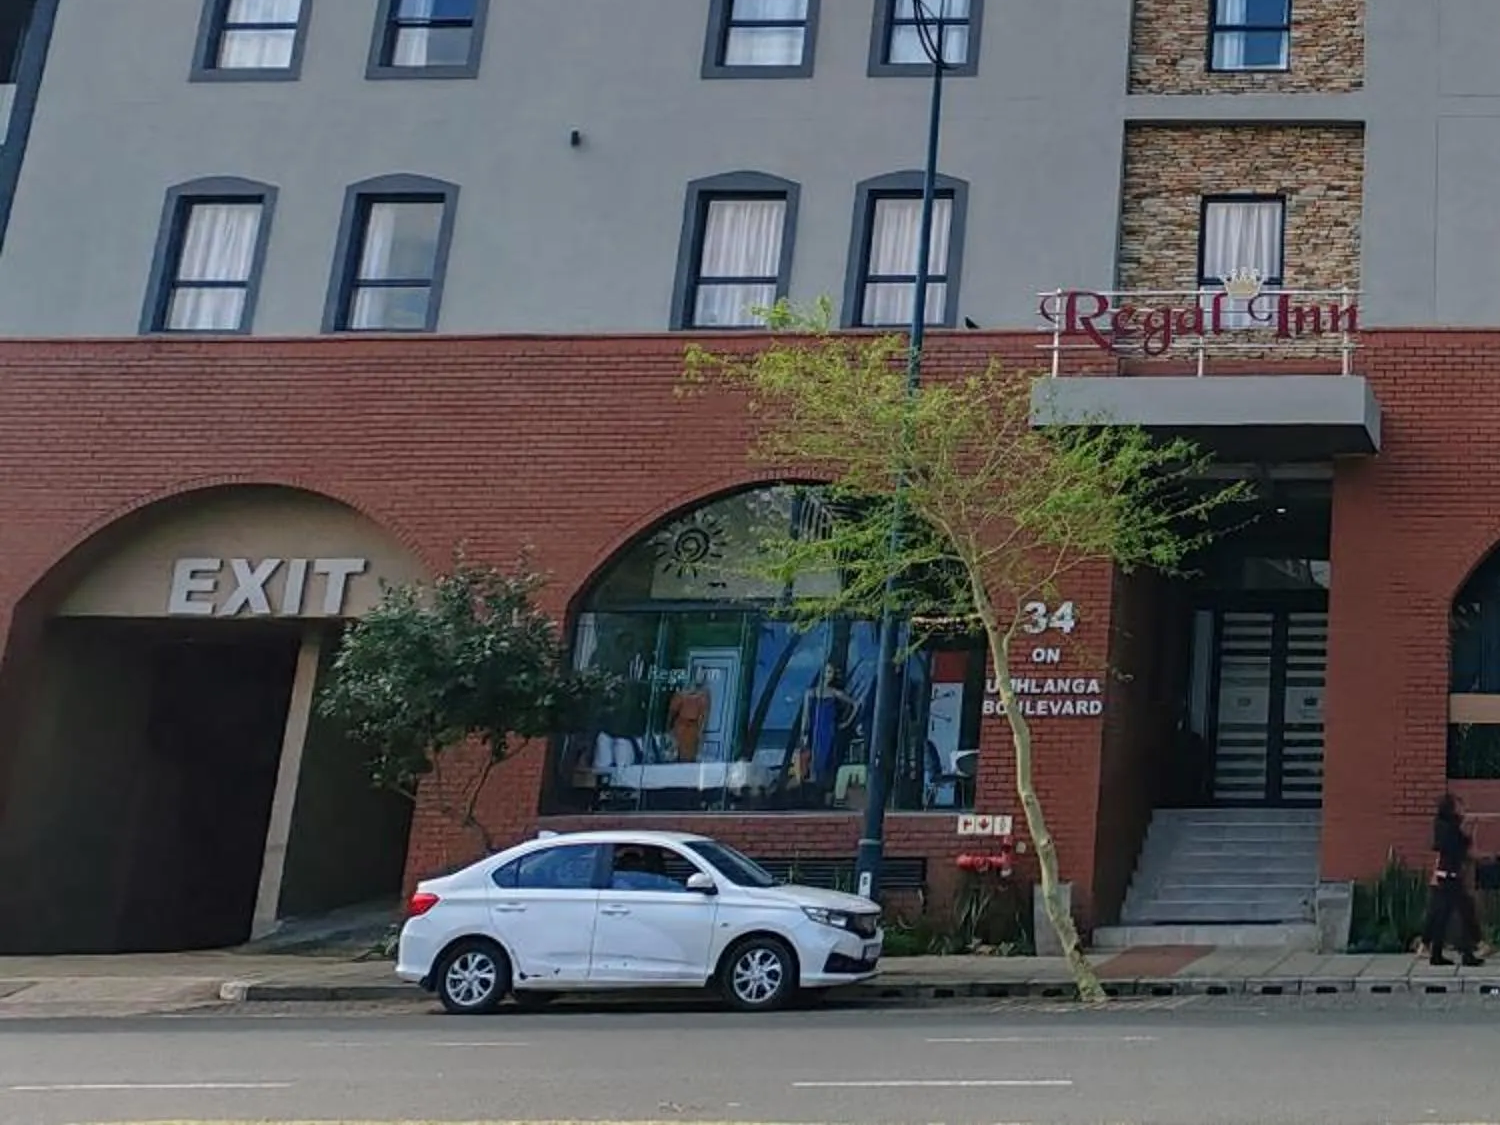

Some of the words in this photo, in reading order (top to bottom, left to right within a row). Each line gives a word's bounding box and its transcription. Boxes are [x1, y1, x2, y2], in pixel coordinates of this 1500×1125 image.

[1039, 290, 1228, 356] Regal
[1247, 292, 1361, 339] Inn
[168, 558, 367, 617] EXIT
[1023, 601, 1077, 634] 34
[1031, 647, 1062, 664] ON
[981, 699, 1104, 716] BOLEVARD
